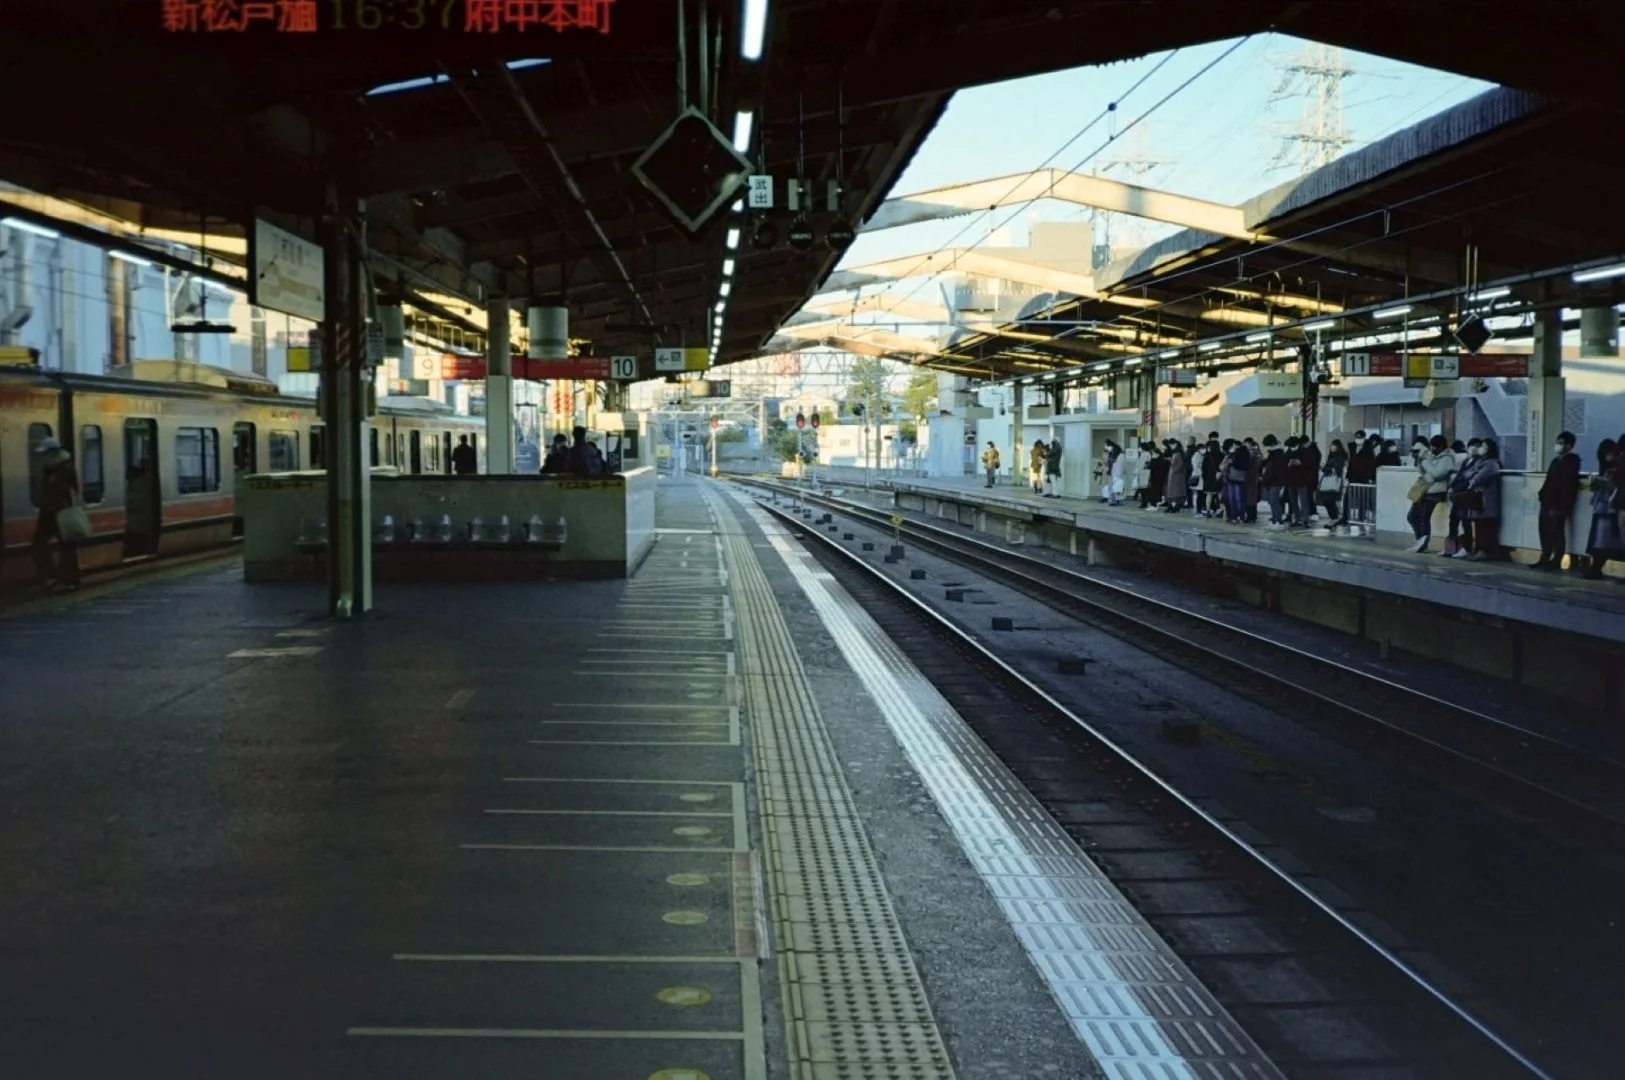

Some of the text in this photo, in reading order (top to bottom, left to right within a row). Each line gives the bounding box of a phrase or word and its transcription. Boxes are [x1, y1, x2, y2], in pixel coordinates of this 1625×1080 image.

[330, 0, 458, 31] 16:37
[463, 0, 616, 34] 府中本町
[421, 357, 434, 377] 9
[613, 358, 634, 377] 10
[1349, 355, 1365, 373] 11
[715, 381, 729, 394] 10
